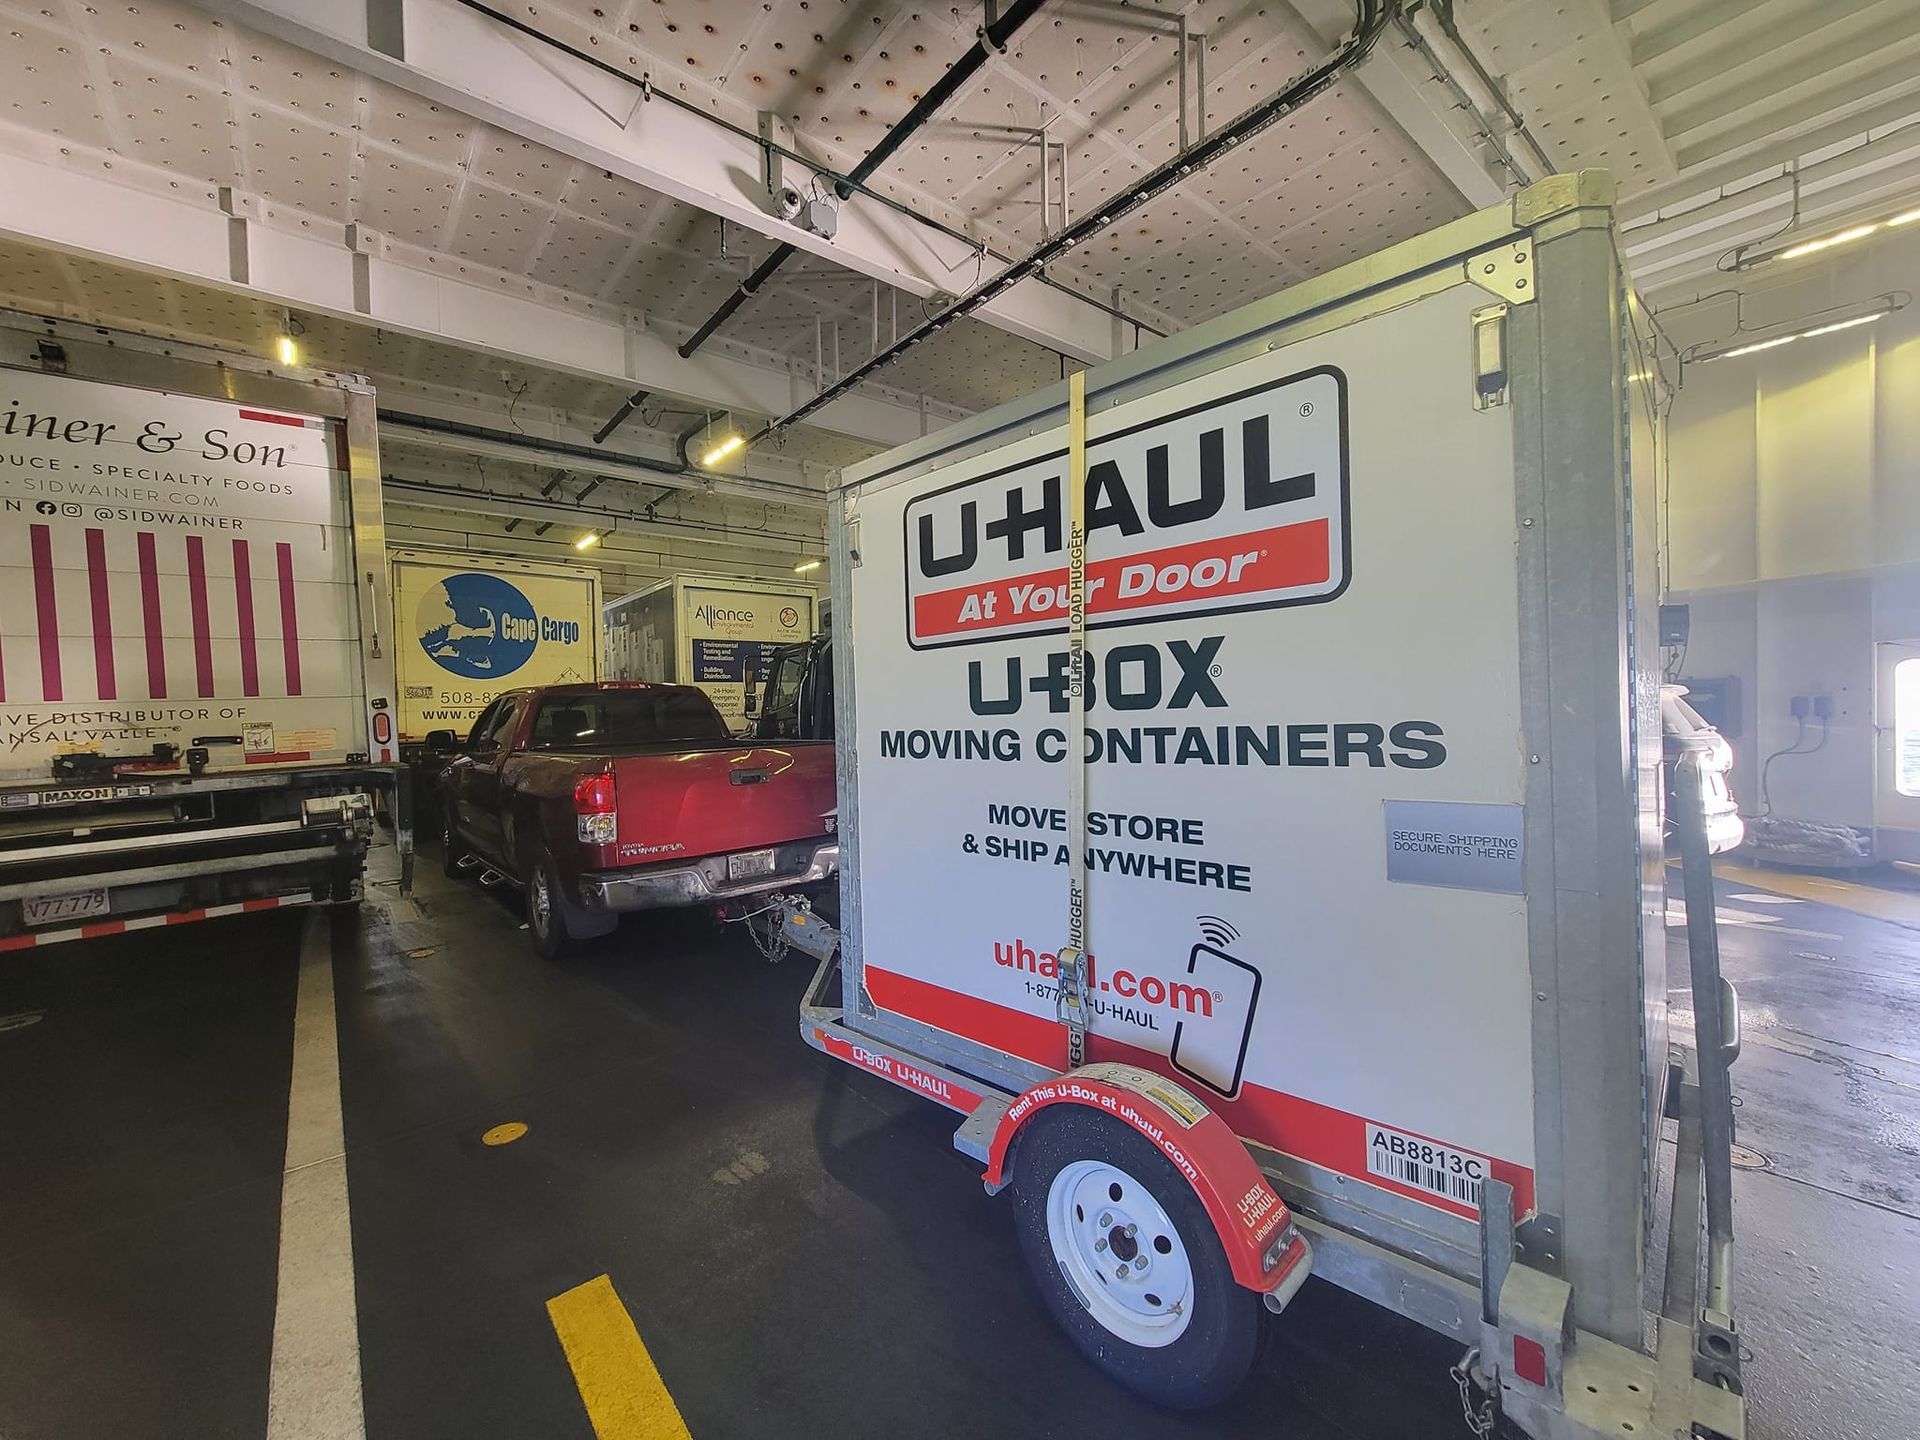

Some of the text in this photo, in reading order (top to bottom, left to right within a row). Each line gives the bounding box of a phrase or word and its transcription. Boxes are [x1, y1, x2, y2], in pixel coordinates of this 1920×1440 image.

[136, 421, 183, 454] &
[23, 478, 219, 508] SIDWAINER.COM
[92, 463, 214, 487] SPECIALTY
[223, 478, 293, 495] FOODS
[919, 414, 1316, 578] U-HAUL
[94, 507, 244, 530] @SIDWAINER
[694, 604, 754, 630] Alliance
[957, 588, 998, 624] At
[1008, 576, 1105, 615] Your
[1070, 594, 1082, 633] LOAD
[501, 612, 579, 645] Cape Cargo
[968, 636, 1229, 716] U-BOX
[52, 708, 209, 725] DISTRIBUTOR
[219, 707, 247, 719] OF
[0, 730, 75, 745] NSAL
[880, 720, 1448, 769] MOVING CONTAINERS
[45, 788, 109, 803] MAXON
[1087, 811, 1204, 845] STORE
[1392, 830, 1518, 848] SECURE SHIPPING
[962, 833, 1252, 892] & SHIP ANYWHERE
[1394, 841, 1516, 860] DOCUMENTS HERE
[994, 939, 1213, 1018] uhal.com
[851, 1046, 952, 1100] U-BOX U-HAUL
[1008, 1096, 1032, 1121] Rent
[1030, 1086, 1056, 1102] This
[1057, 1084, 1099, 1103] U-Box
[1101, 1095, 1117, 1110] at
[1120, 1104, 1198, 1181] uhaul.com
[1372, 1131, 1482, 1180] AB8813C
[1236, 1183, 1265, 1214] U-BOX
[1243, 1193, 1277, 1228] U-HAUL
[1254, 1205, 1288, 1242] uhaul.com
